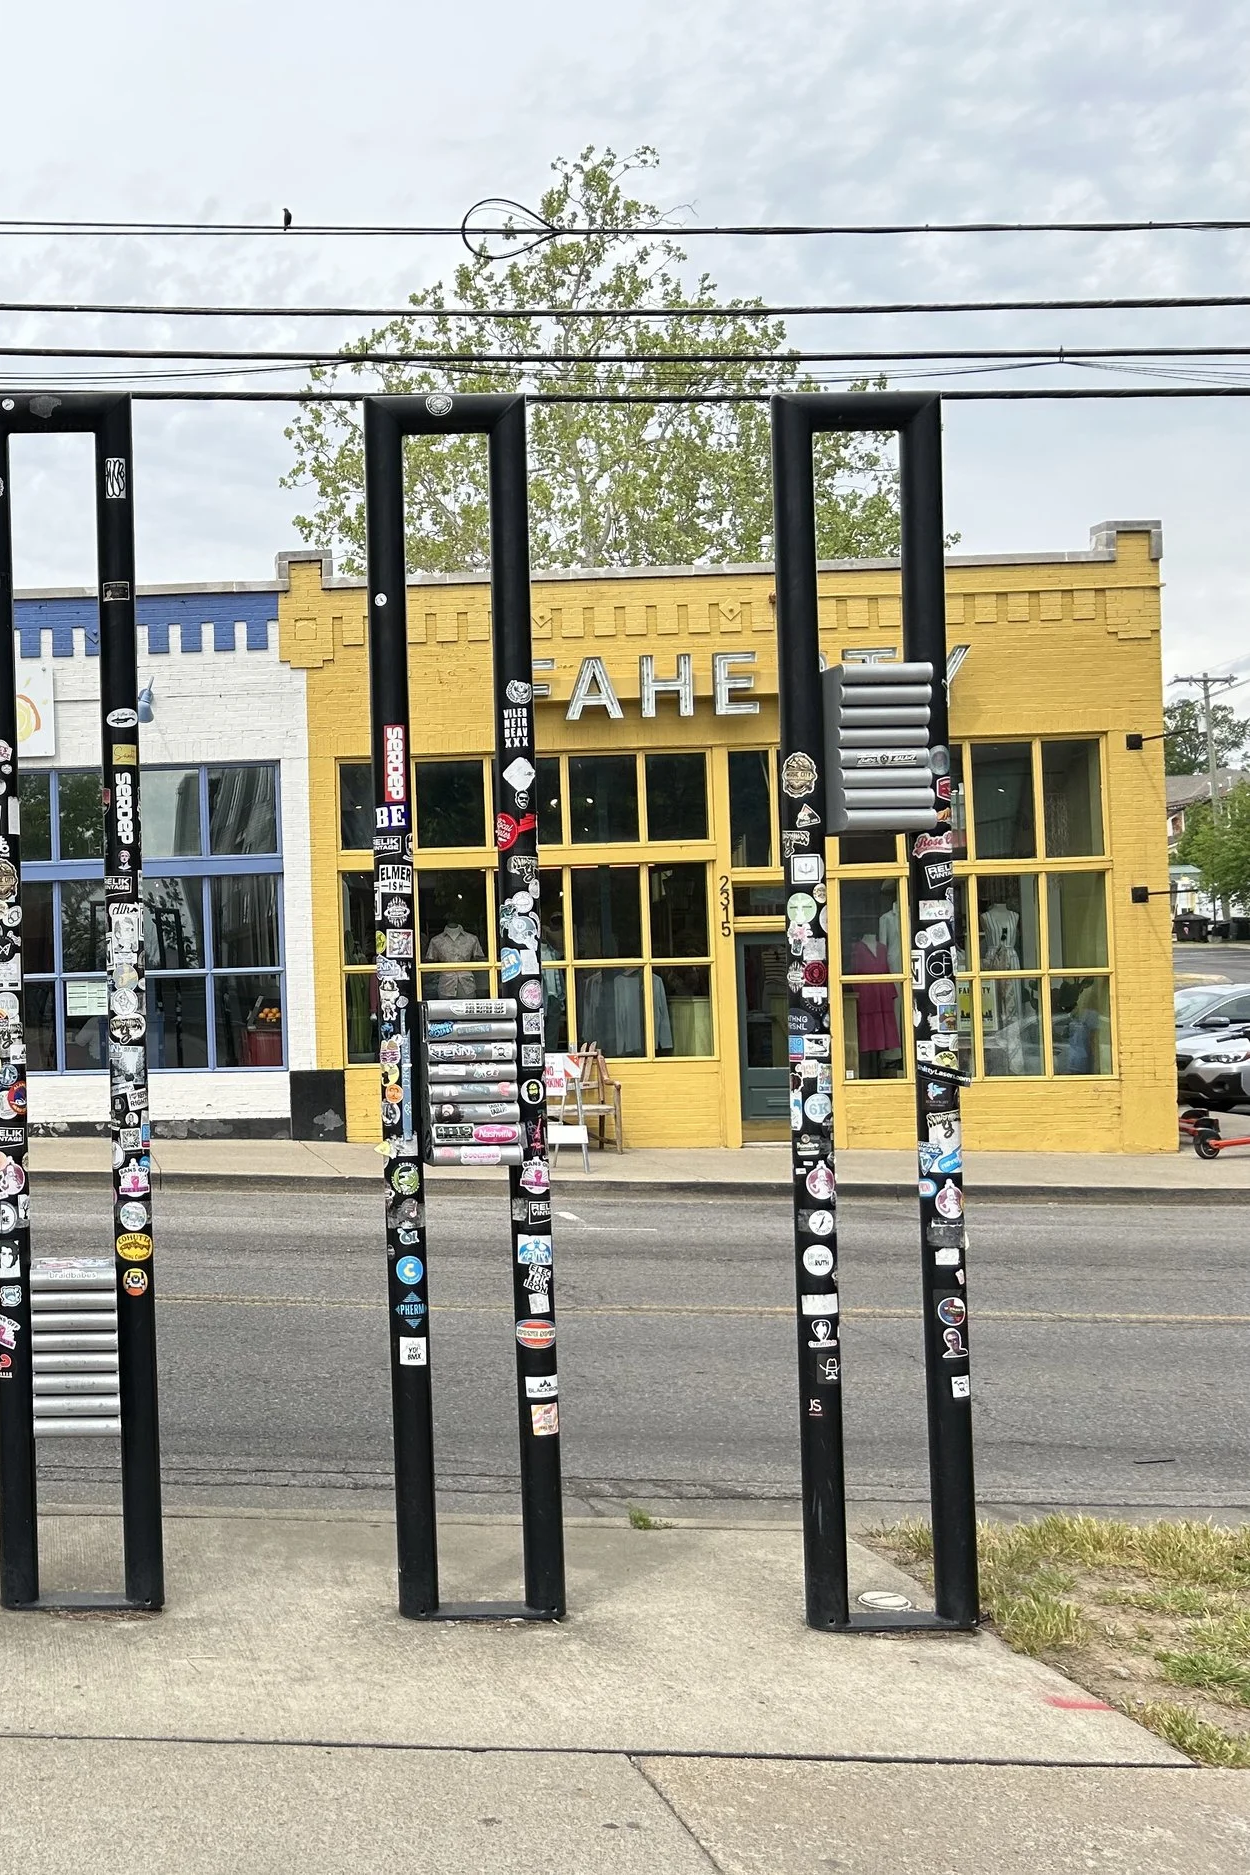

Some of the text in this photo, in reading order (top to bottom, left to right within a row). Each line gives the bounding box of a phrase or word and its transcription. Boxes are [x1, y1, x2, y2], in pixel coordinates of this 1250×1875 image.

[375, 805, 406, 828] BE
[917, 835, 940, 848] Rose
[381, 865, 411, 881] ELMER
[388, 881, 404, 891] ISH
[719, 875, 731, 937] 2315
[958, 987, 991, 995] FATY
[546, 1078, 564, 1088] RKING
[809, 1103, 830, 1116] 6K
[479, 1128, 513, 1138] Nashville
[523, 1161, 541, 1169] BANS
[119, 1167, 137, 1176] BANS
[117, 1234, 151, 1245] COHUTTA
[49, 1271, 97, 1279] braidbabes
[530, 1263, 551, 1277] ELEC
[528, 1270, 549, 1287] TRIC
[523, 1279, 548, 1294] IRON
[7, 1318, 20, 1329] OFF
[407, 1352, 422, 1361] BMX
[808, 1398, 822, 1412] JS
